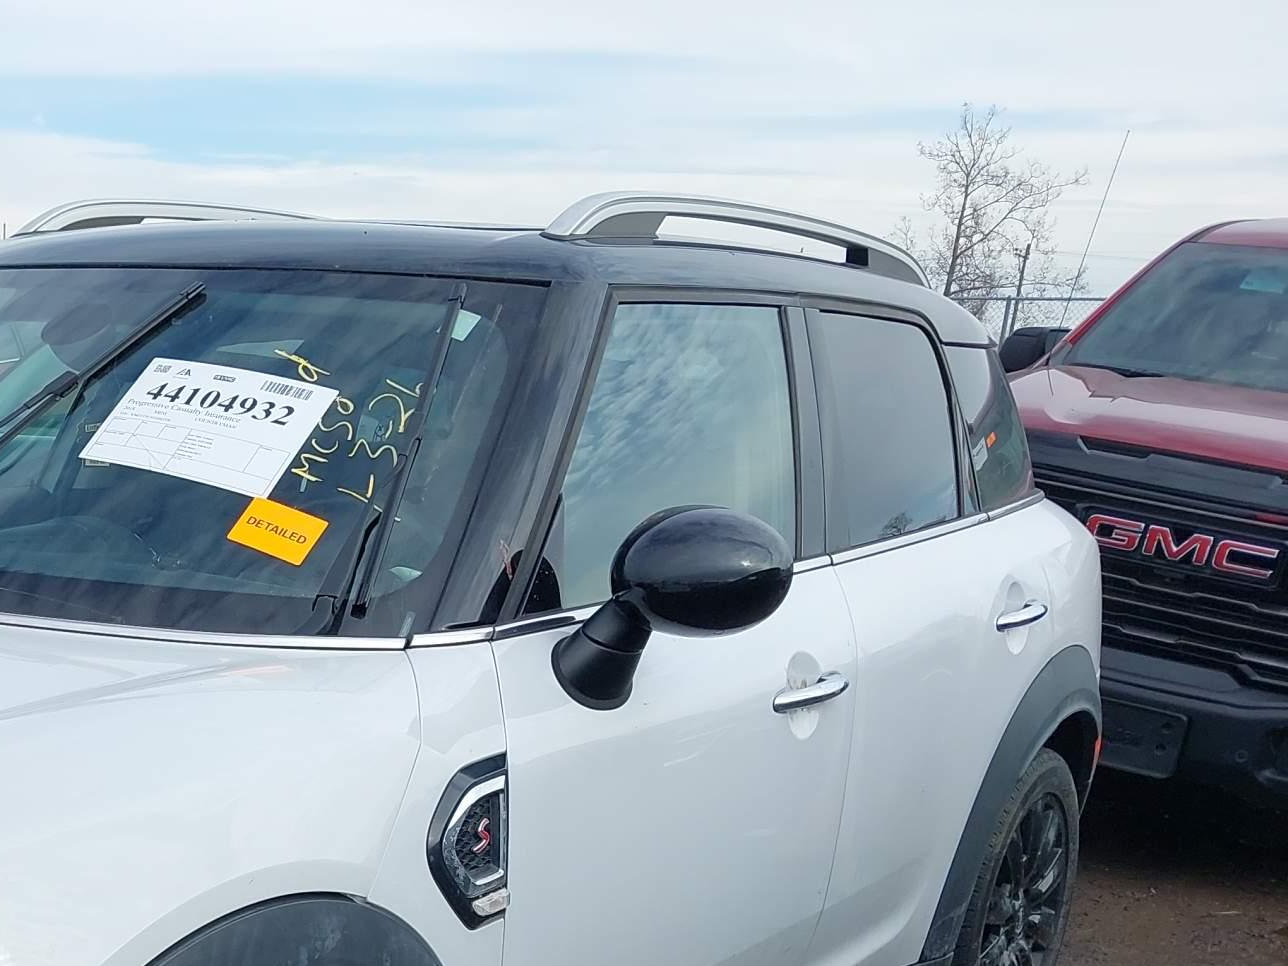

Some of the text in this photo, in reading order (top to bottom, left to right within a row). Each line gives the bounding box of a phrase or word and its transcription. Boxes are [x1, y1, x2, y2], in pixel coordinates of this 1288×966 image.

[128, 398, 170, 410] Progressive
[171, 404, 201, 416] Casualty
[205, 410, 241, 423] Insurance
[146, 382, 296, 426] 44104932
[245, 515, 308, 545] DETAILED
[1086, 514, 1279, 579] GMC
[472, 817, 490, 854] S
